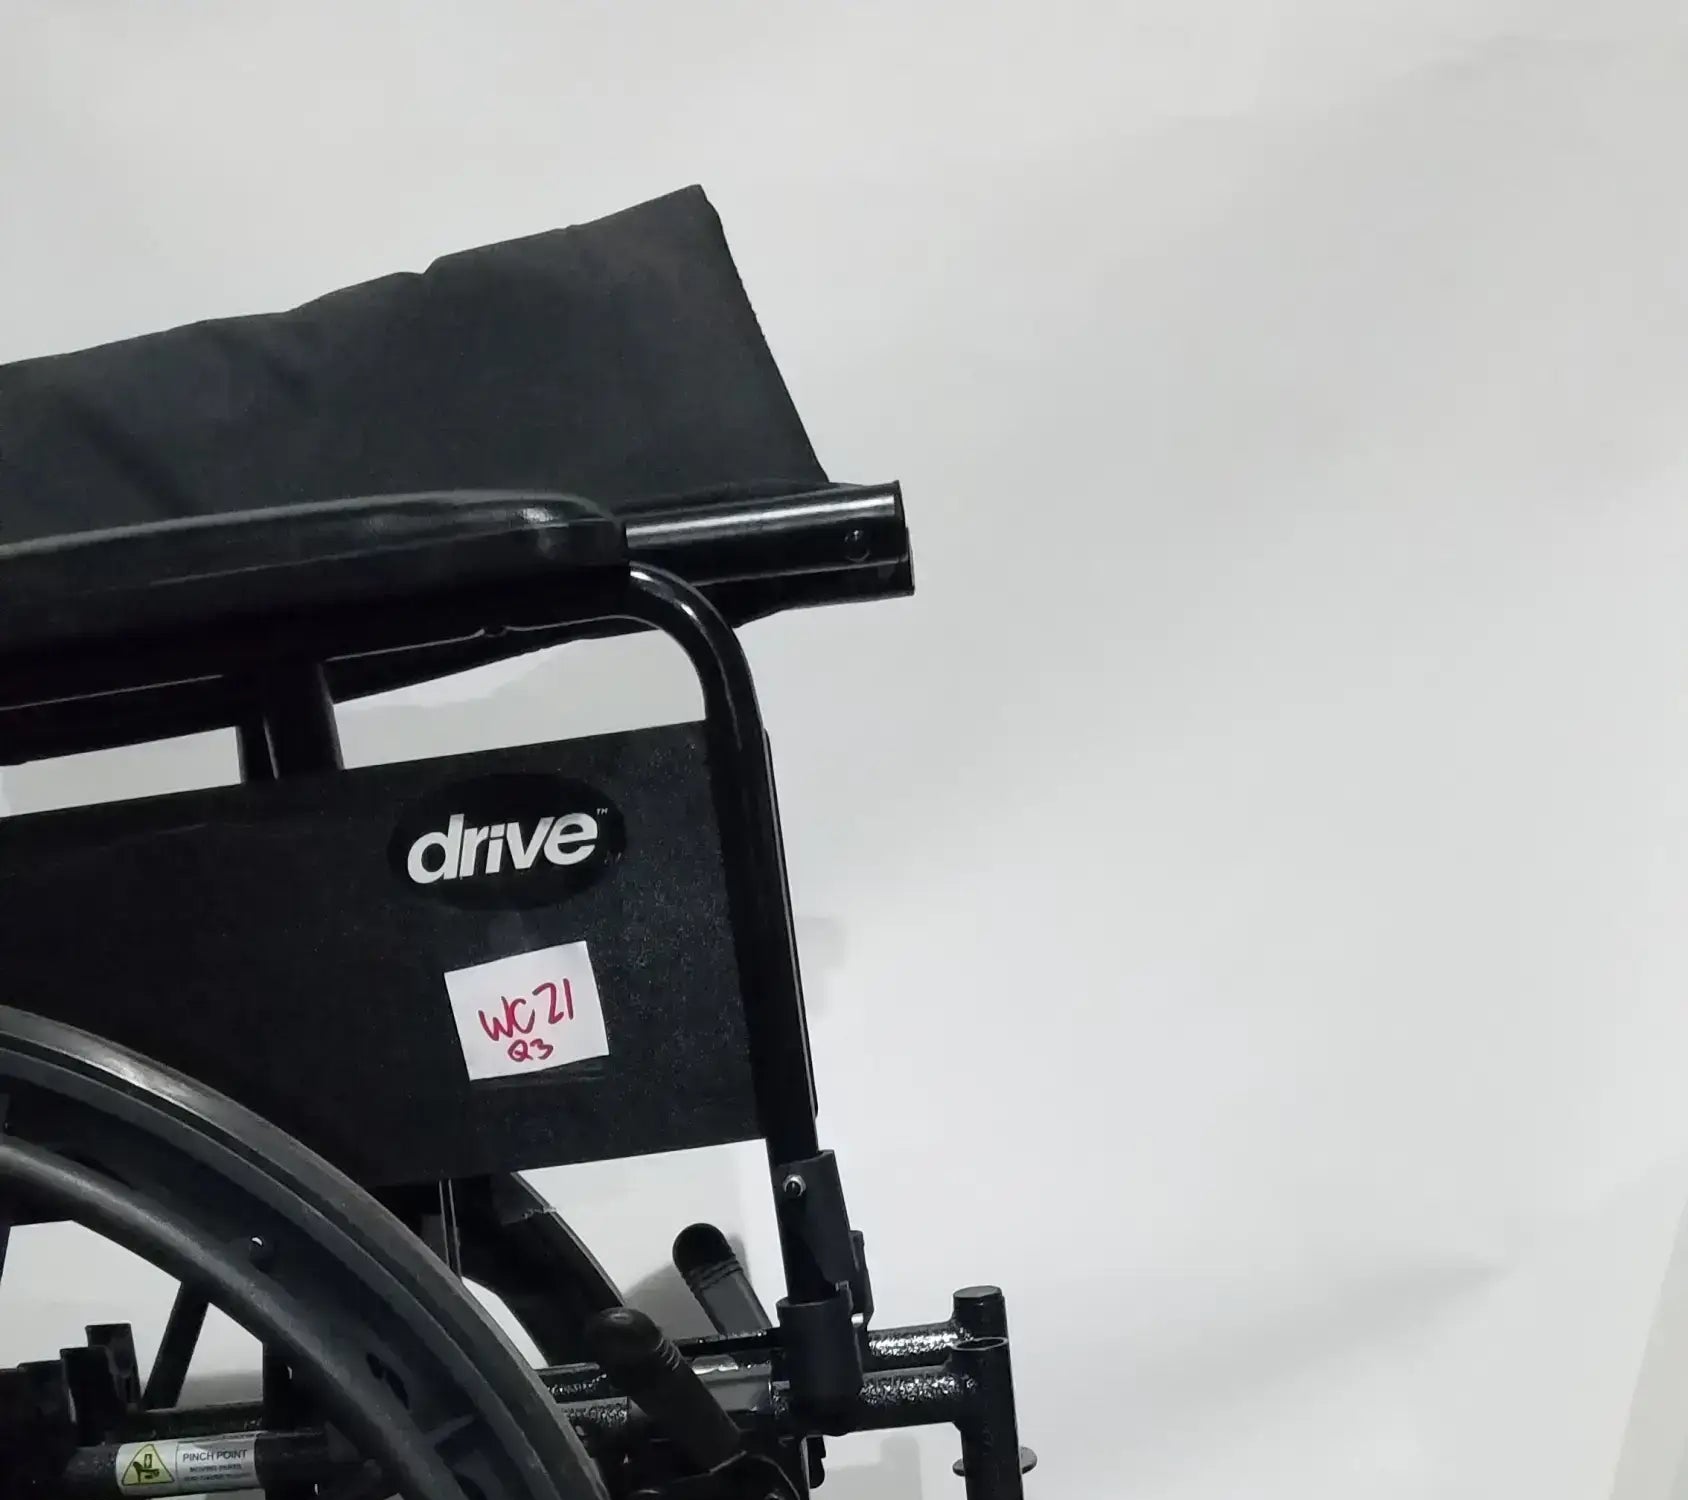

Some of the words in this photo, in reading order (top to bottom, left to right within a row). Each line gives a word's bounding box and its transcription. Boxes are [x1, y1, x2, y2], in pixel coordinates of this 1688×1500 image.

[407, 813, 598, 884] drive
[507, 1037, 555, 1063] Q3
[182, 1451, 214, 1462] PINCH
[216, 1449, 248, 1460] POINT
